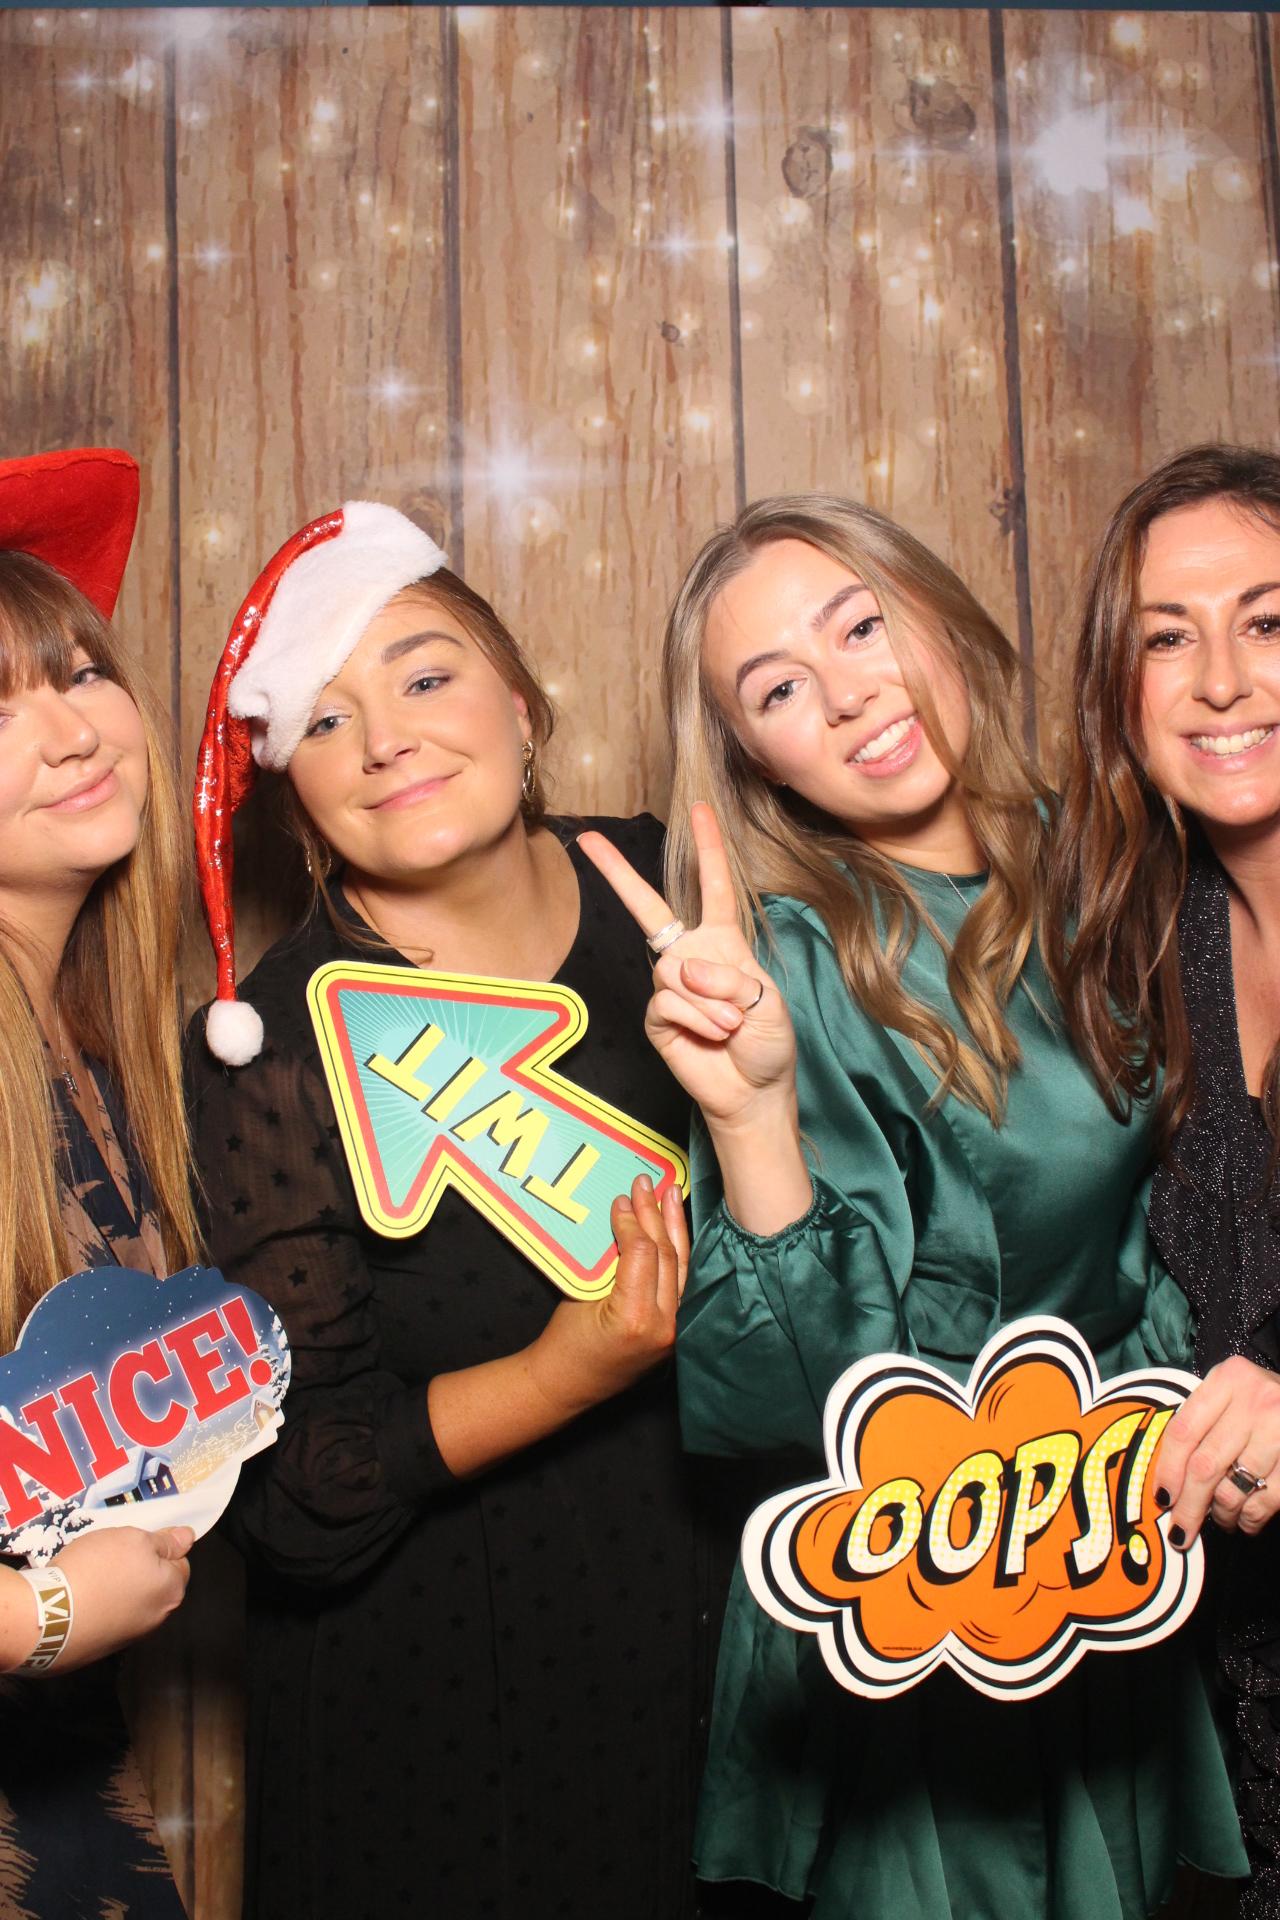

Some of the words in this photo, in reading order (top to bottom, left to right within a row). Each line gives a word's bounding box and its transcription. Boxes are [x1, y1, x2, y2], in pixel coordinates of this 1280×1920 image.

[364, 1023, 600, 1225] TWIT
[0, 1295, 273, 1531] NICE!
[834, 1406, 1175, 1589] OOPS!
